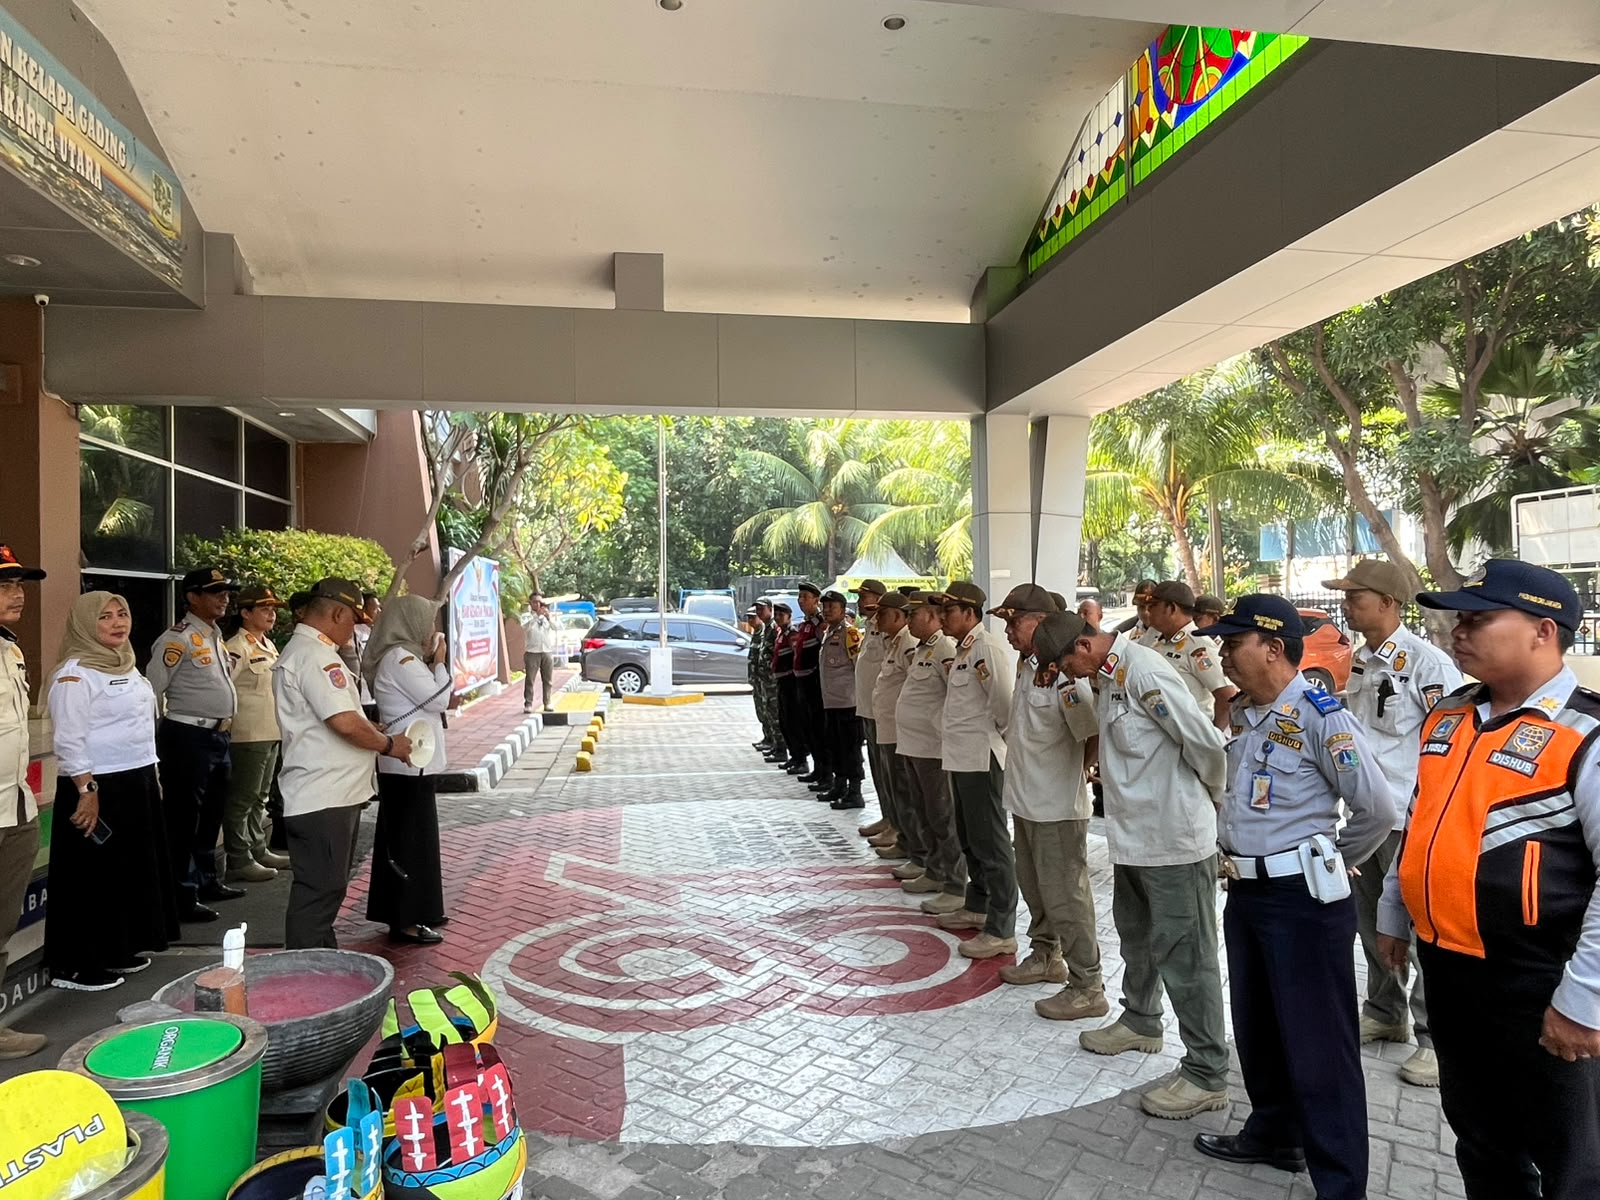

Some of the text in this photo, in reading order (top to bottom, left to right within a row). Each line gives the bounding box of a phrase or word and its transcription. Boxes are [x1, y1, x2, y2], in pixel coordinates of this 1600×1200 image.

[15, 46, 76, 125] KELAPA
[79, 104, 127, 169] GADING
[0, 84, 103, 191] KARTA UTARA
[1269, 731, 1301, 750] DISHUB
[1492, 753, 1533, 773] DISHUB
[151, 1026, 179, 1070] ORGANIK
